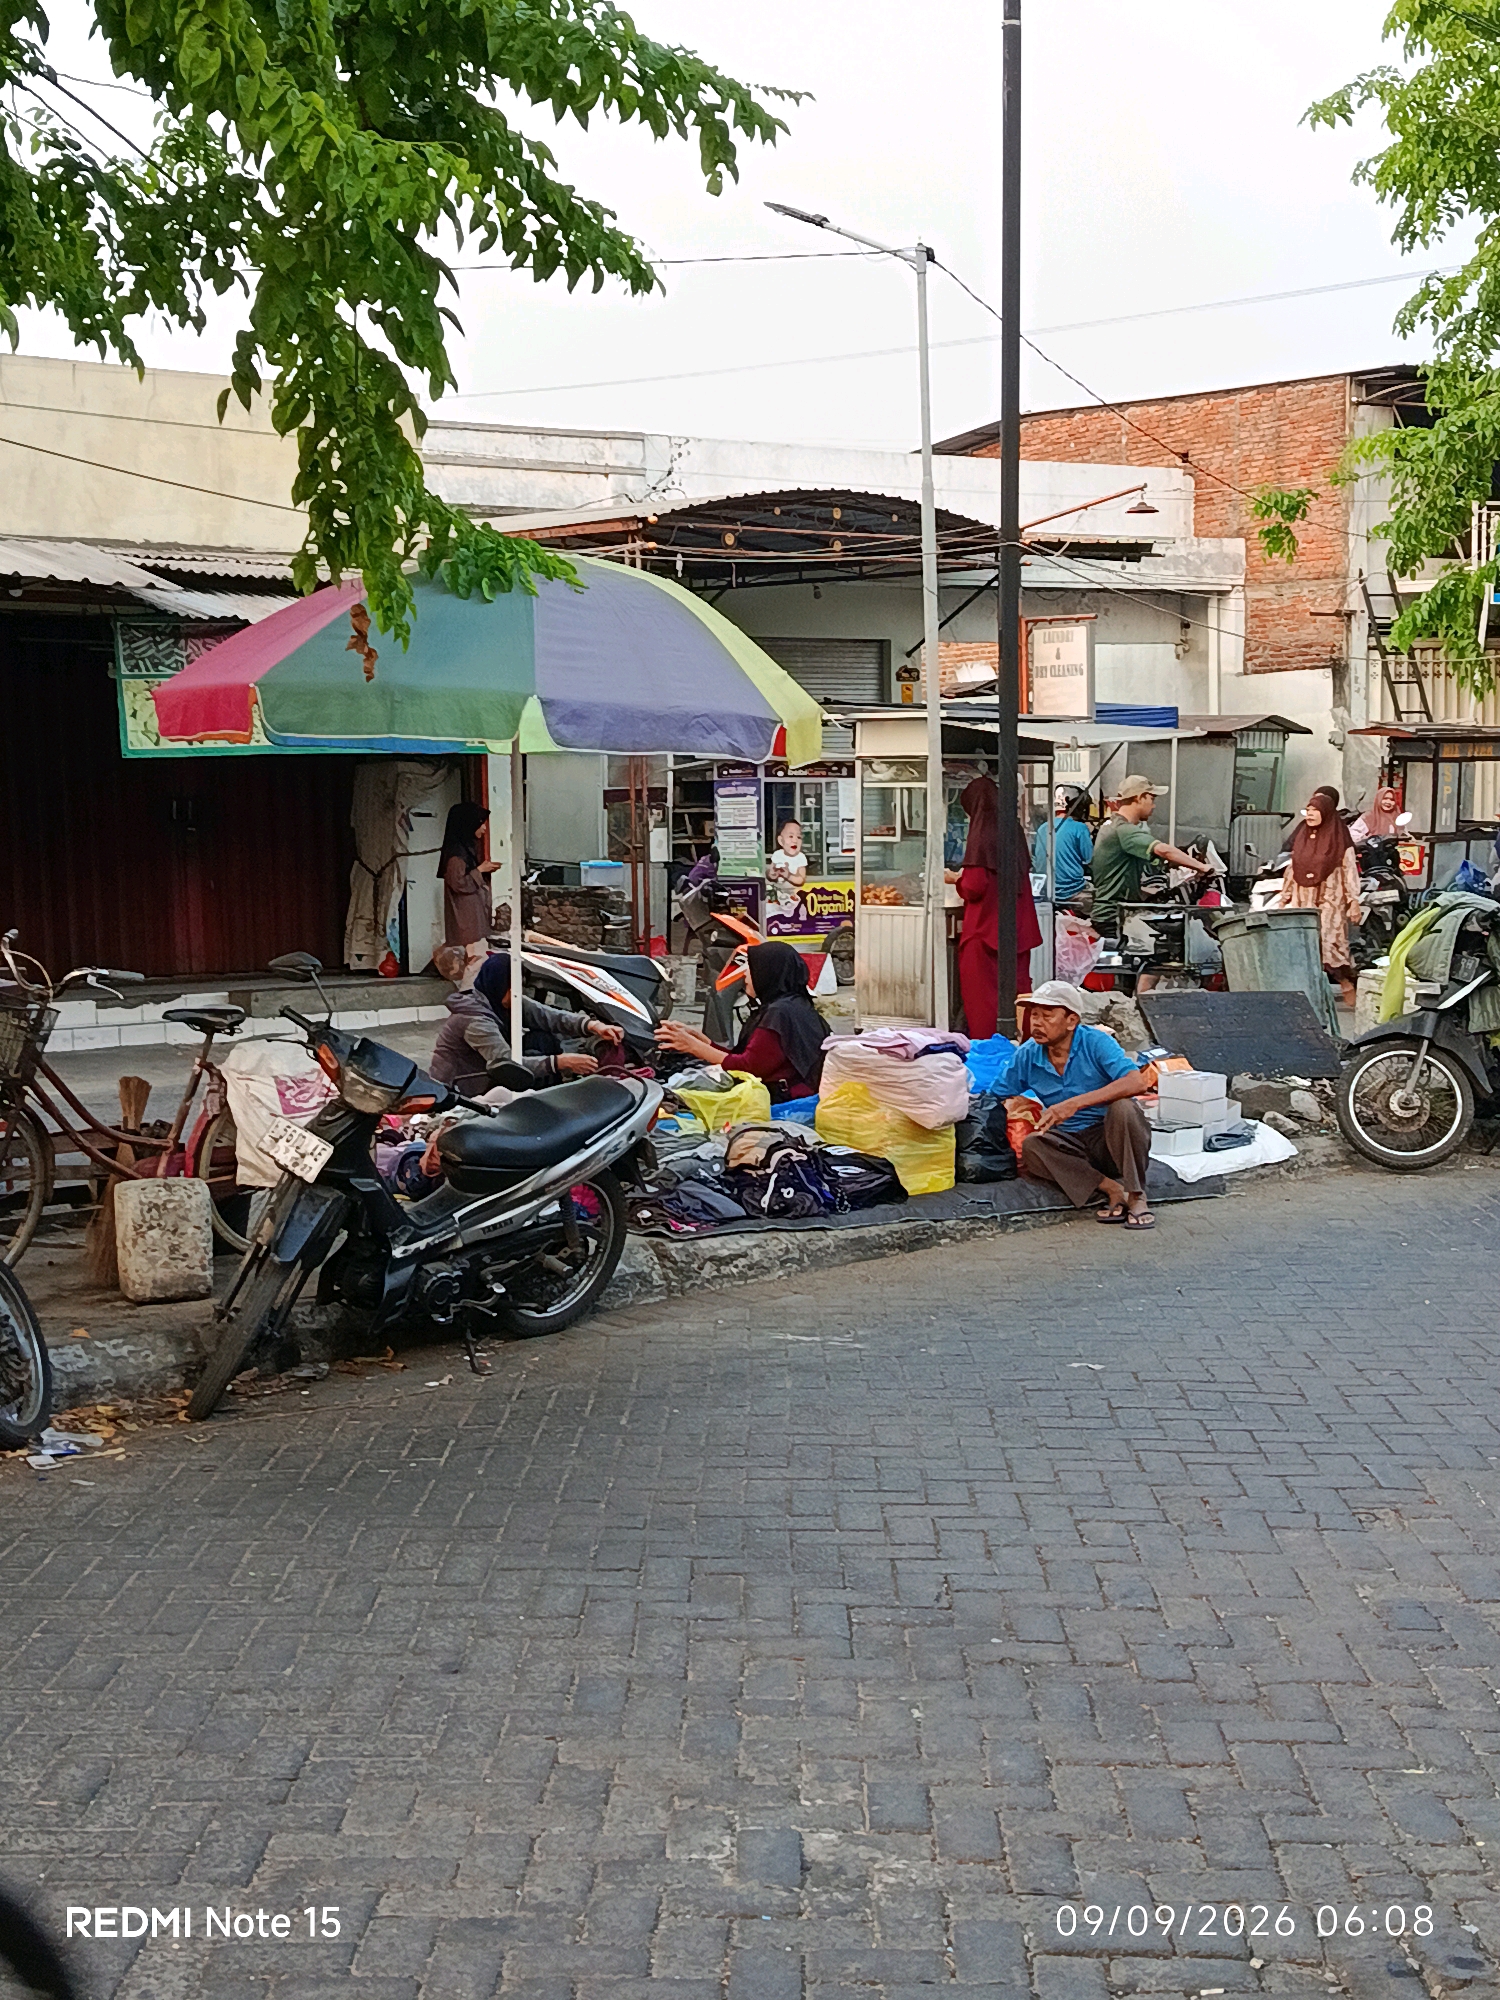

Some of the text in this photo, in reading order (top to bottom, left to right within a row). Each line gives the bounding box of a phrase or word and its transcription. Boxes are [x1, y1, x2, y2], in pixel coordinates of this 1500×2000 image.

[1034, 663, 1084, 679] DRY CLEANING
[805, 892, 854, 917] Organik
